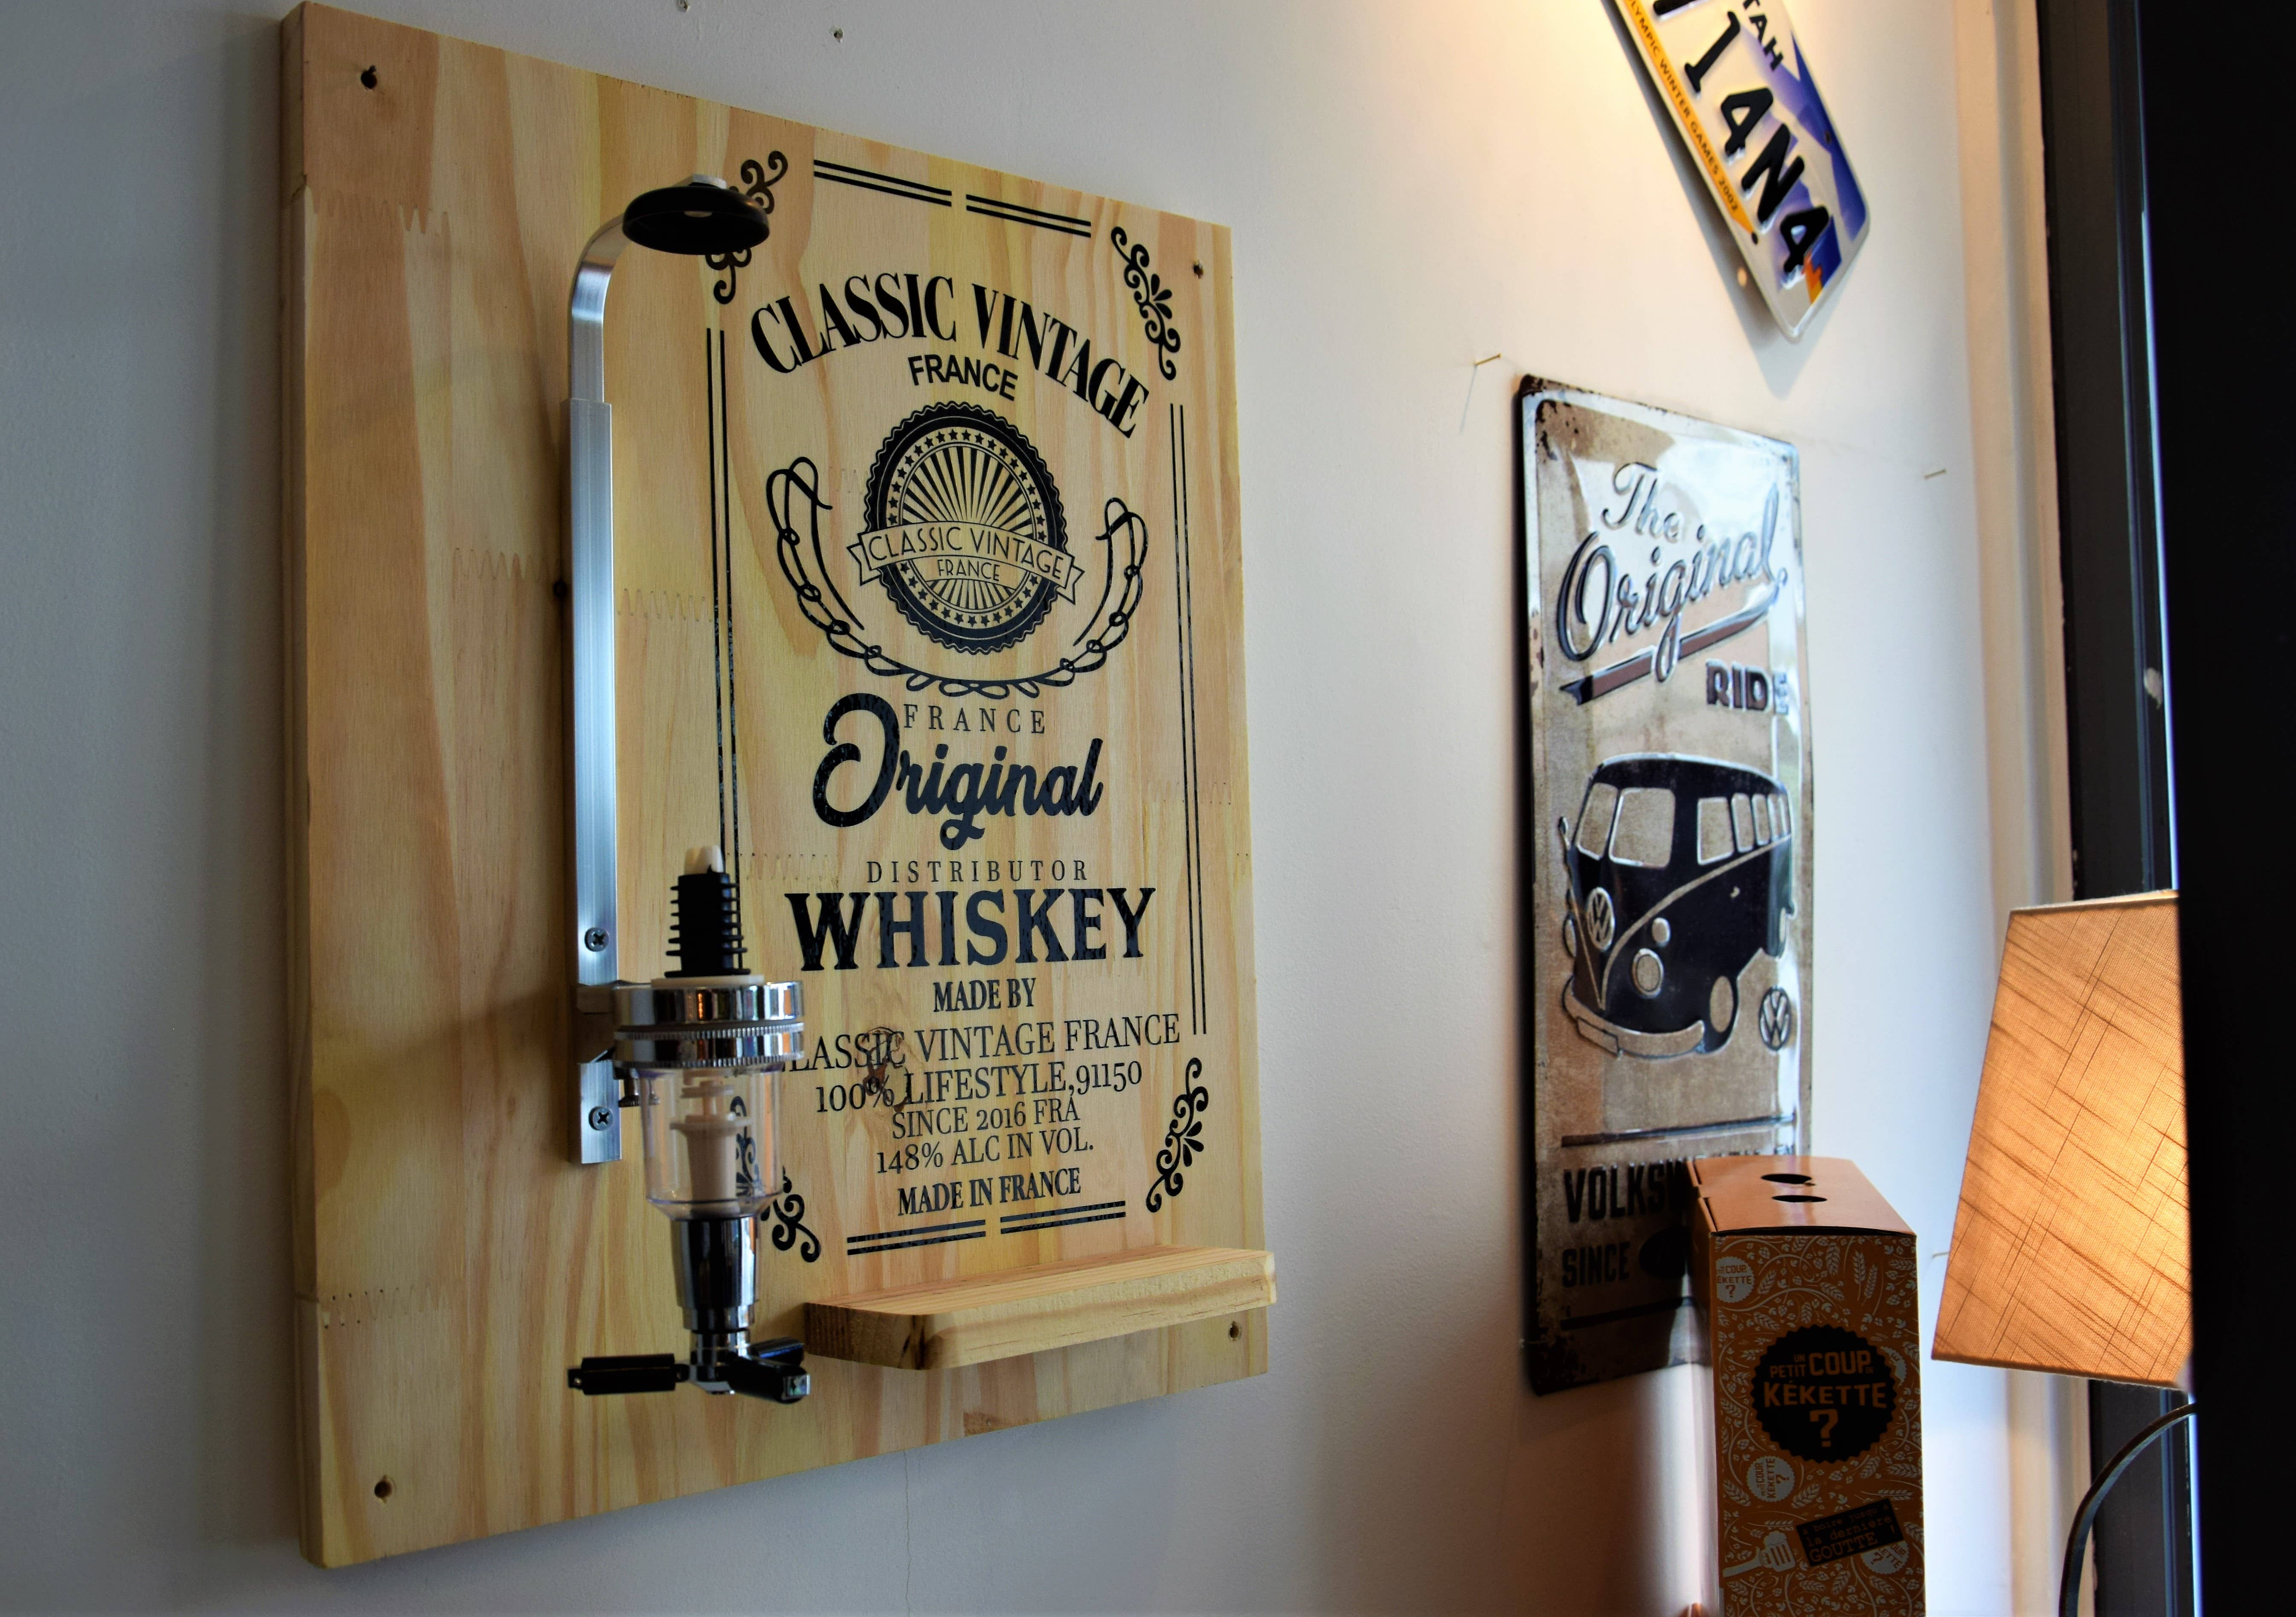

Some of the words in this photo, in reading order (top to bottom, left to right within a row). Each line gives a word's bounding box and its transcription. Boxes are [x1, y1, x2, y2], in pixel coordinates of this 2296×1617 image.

[1743, 0, 1783, 70] TAH
[1629, 0, 1660, 57] LYMPIC
[1660, 59, 1690, 118] WINTER
[1691, 121, 1718, 174] GAMES
[1718, 180, 1738, 211] 2002
[1653, 0, 1829, 275] 14N4
[751, 273, 957, 374] CLASSIC
[971, 283, 1150, 439] VINTAGE
[909, 354, 1018, 401] FRANCE
[1602, 462, 1684, 542] The
[868, 526, 963, 561] CLASSIC
[970, 527, 1062, 580] VINTAGE
[938, 558, 1000, 582] FRANCE
[1557, 481, 1786, 682] Original
[1706, 660, 1788, 715] RIDE
[903, 704, 1046, 734] FRANCE
[813, 693, 1103, 850] Original
[867, 860, 1087, 883] DISTRIBUTOR
[784, 887, 1156, 971] WHISKEY
[933, 980, 1001, 1012] MADE
[1007, 977, 1036, 1008] BY
[783, 1029, 906, 1072] LASSIC
[915, 1021, 1055, 1063] VINTAGE
[1064, 1013, 1180, 1053] FRANCE
[816, 1075, 895, 1112] 100%
[903, 1059, 1143, 1107] LIFESTYLE,91150
[892, 1106, 968, 1140] SINCE
[976, 1101, 1026, 1131] 2016
[1033, 1096, 1081, 1125] FRA
[877, 1141, 944, 1174] 148%
[951, 1135, 1000, 1166] ALC
[1007, 1131, 1033, 1160] IN
[1039, 1127, 1094, 1155] VOL.
[898, 1181, 964, 1216] MADE
[969, 1177, 994, 1207] IN
[999, 1167, 1081, 1204] FRANCE
[1562, 1242, 1630, 1288] SINCE
[1717, 1275, 1752, 1285] EKETTE
[1770, 1364, 1806, 1378] PETIT
[1809, 1350, 1871, 1376] COUP
[1793, 1354, 1806, 1362] UN
[1764, 1380, 1887, 1408] KÉKETTE
[1809, 1409, 1838, 1447] ?
[1806, 1537, 1823, 1547] la
[1809, 1532, 1878, 1562] GOUTTE
[1813, 1518, 1843, 1532] boire
